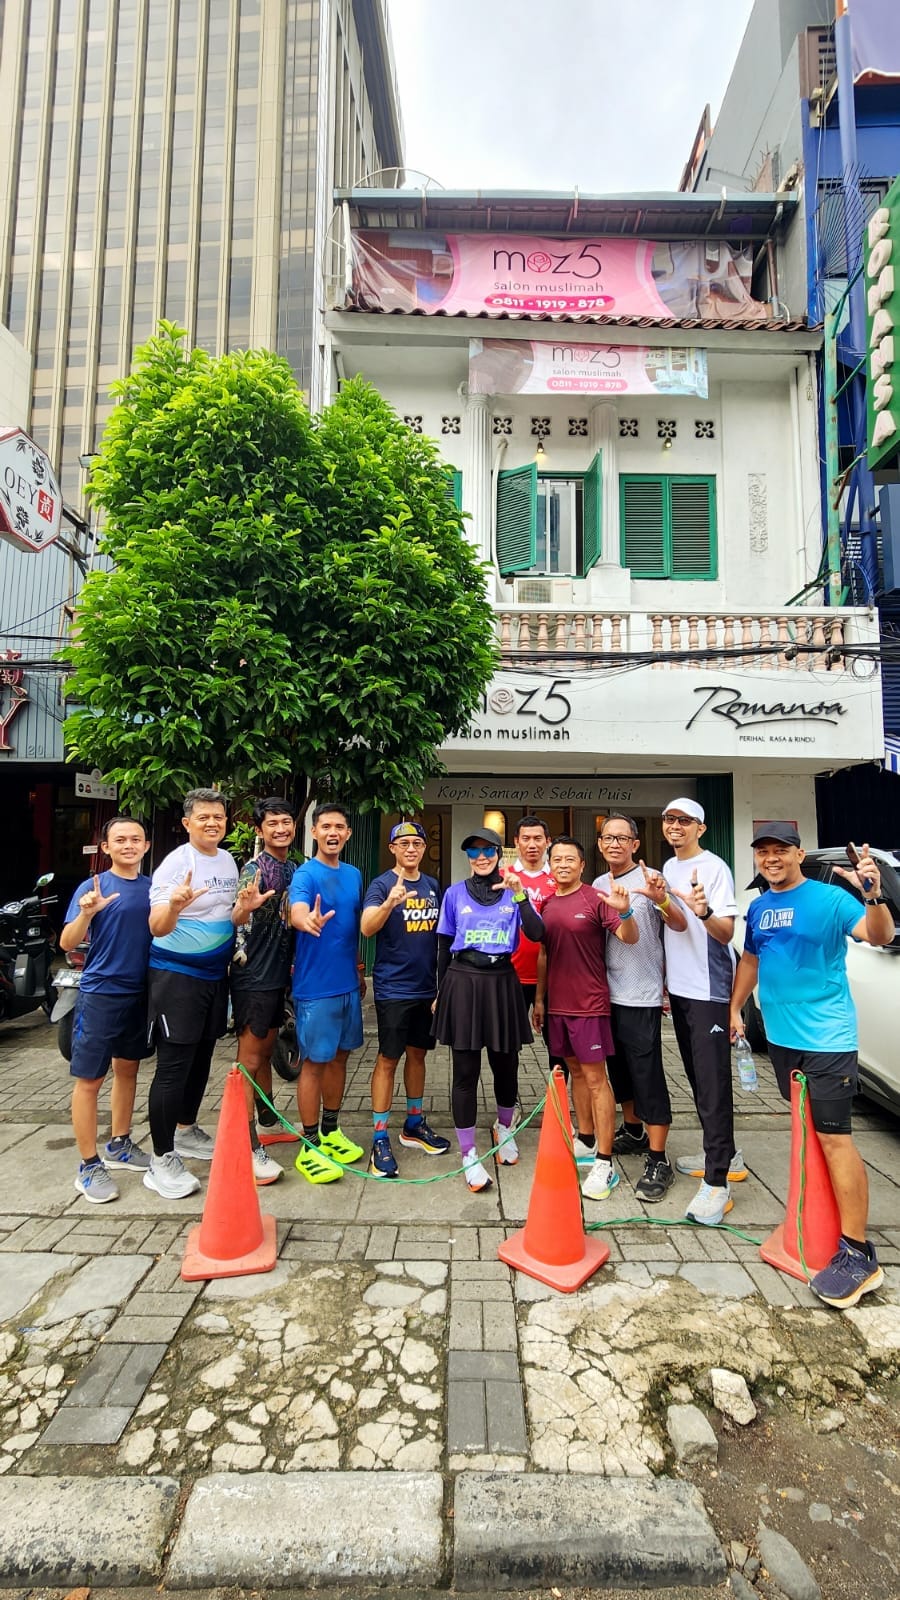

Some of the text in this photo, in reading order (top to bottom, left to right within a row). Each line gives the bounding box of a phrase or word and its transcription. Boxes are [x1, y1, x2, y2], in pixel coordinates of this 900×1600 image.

[494, 280, 604, 292] salon muslimah
[492, 297, 525, 307] 0811
[536, 299, 567, 309] 1919
[578, 297, 605, 309] 878
[552, 368, 622, 377] salon muslimah
[4, 466, 38, 505] OEY
[685, 686, 848, 730] Romansa
[497, 726, 570, 741] muslimah
[479, 785, 529, 801] Santap
[533, 785, 545, 800] &
[549, 786, 593, 800] Sebait
[598, 787, 633, 801] Puisi
[405, 897, 436, 909] RUN
[402, 908, 439, 921] YOUR
[774, 911, 794, 921] LAWU
[406, 919, 437, 932] WAY
[464, 929, 510, 945] BERLIN
